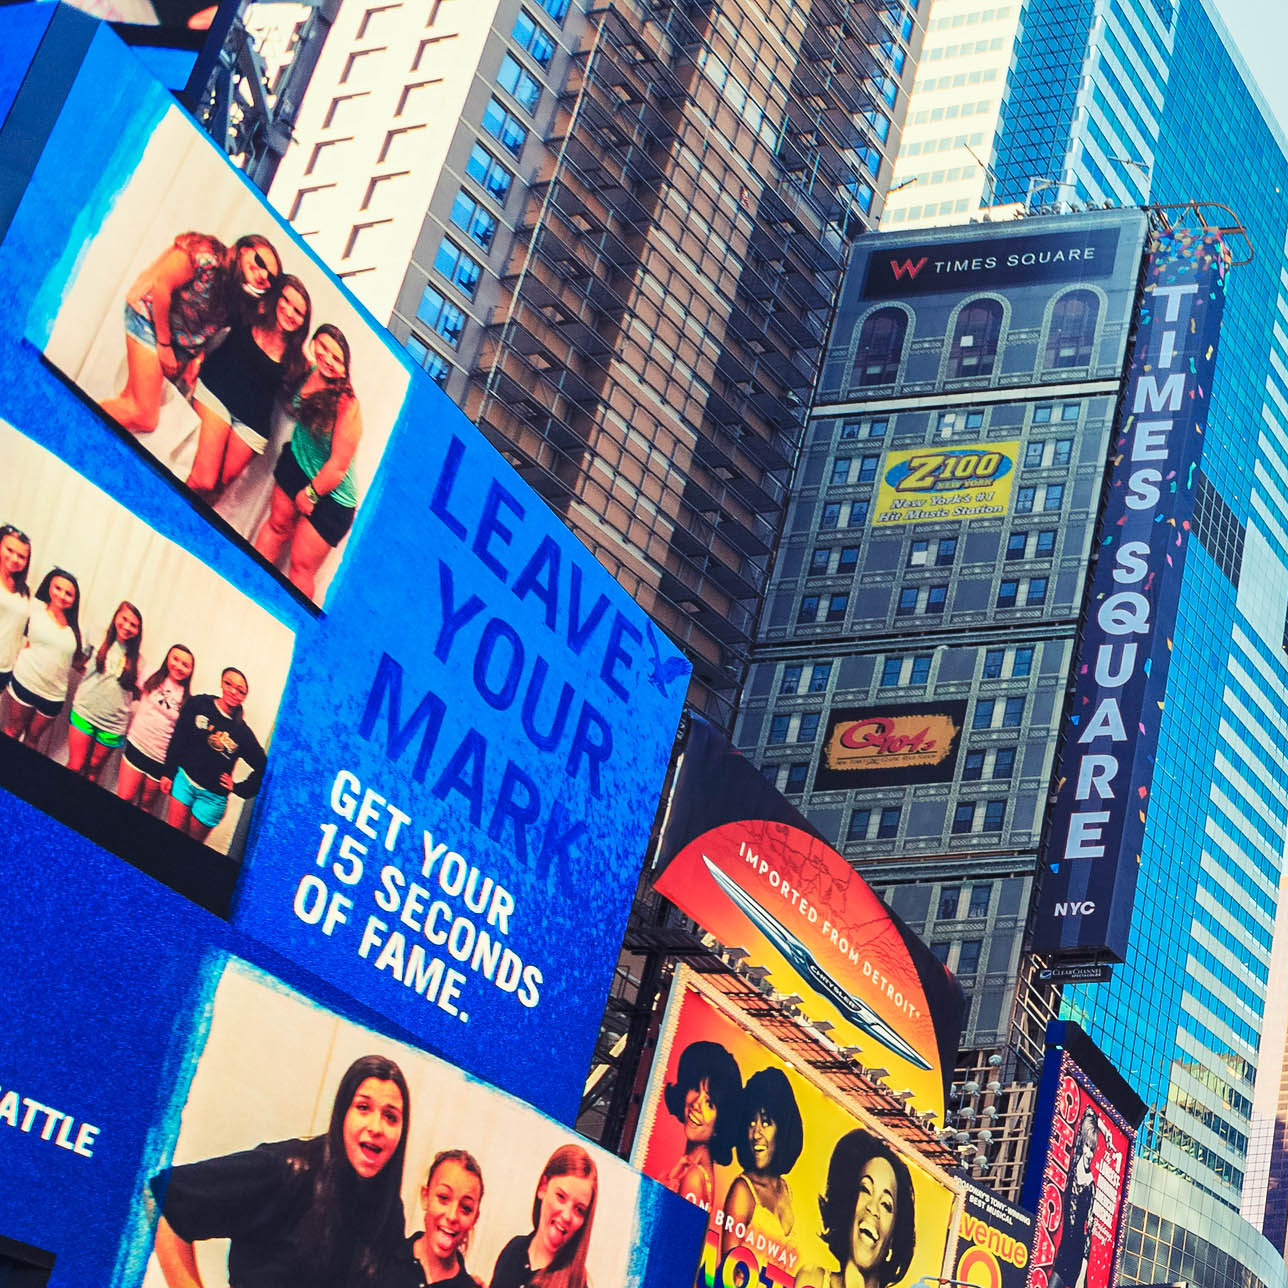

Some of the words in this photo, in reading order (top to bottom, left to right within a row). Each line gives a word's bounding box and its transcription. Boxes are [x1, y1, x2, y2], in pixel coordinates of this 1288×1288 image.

[934, 256, 996, 273] TIMES
[1008, 248, 1095, 267] SQUARE
[1126, 284, 1198, 511] TIMES
[878, 511, 901, 522] Hit
[904, 509, 949, 520] Music
[952, 505, 1003, 516] Station
[890, 499, 927, 509] New
[930, 495, 972, 506] York's
[976, 492, 994, 502] #1
[895, 453, 1002, 492] Z100
[429, 434, 643, 702] LEAVE
[433, 558, 614, 799] YOUR
[1064, 541, 1150, 860] SQUARE
[358, 652, 589, 890] MARK
[317, 822, 364, 886] 15
[374, 866, 543, 1008] SECONDS
[330, 769, 410, 850] GET
[422, 829, 516, 935] YOUR
[739, 842, 818, 923] IMPORTED
[822, 921, 859, 965] FROM
[1054, 901, 1096, 917] NYC
[293, 874, 352, 937] OF
[359, 918, 469, 1023] FAME.
[810, 965, 857, 1011] CHRYSLER
[968, 1194, 987, 1209] BEST
[986, 1203, 1014, 1226] MUSICAL
